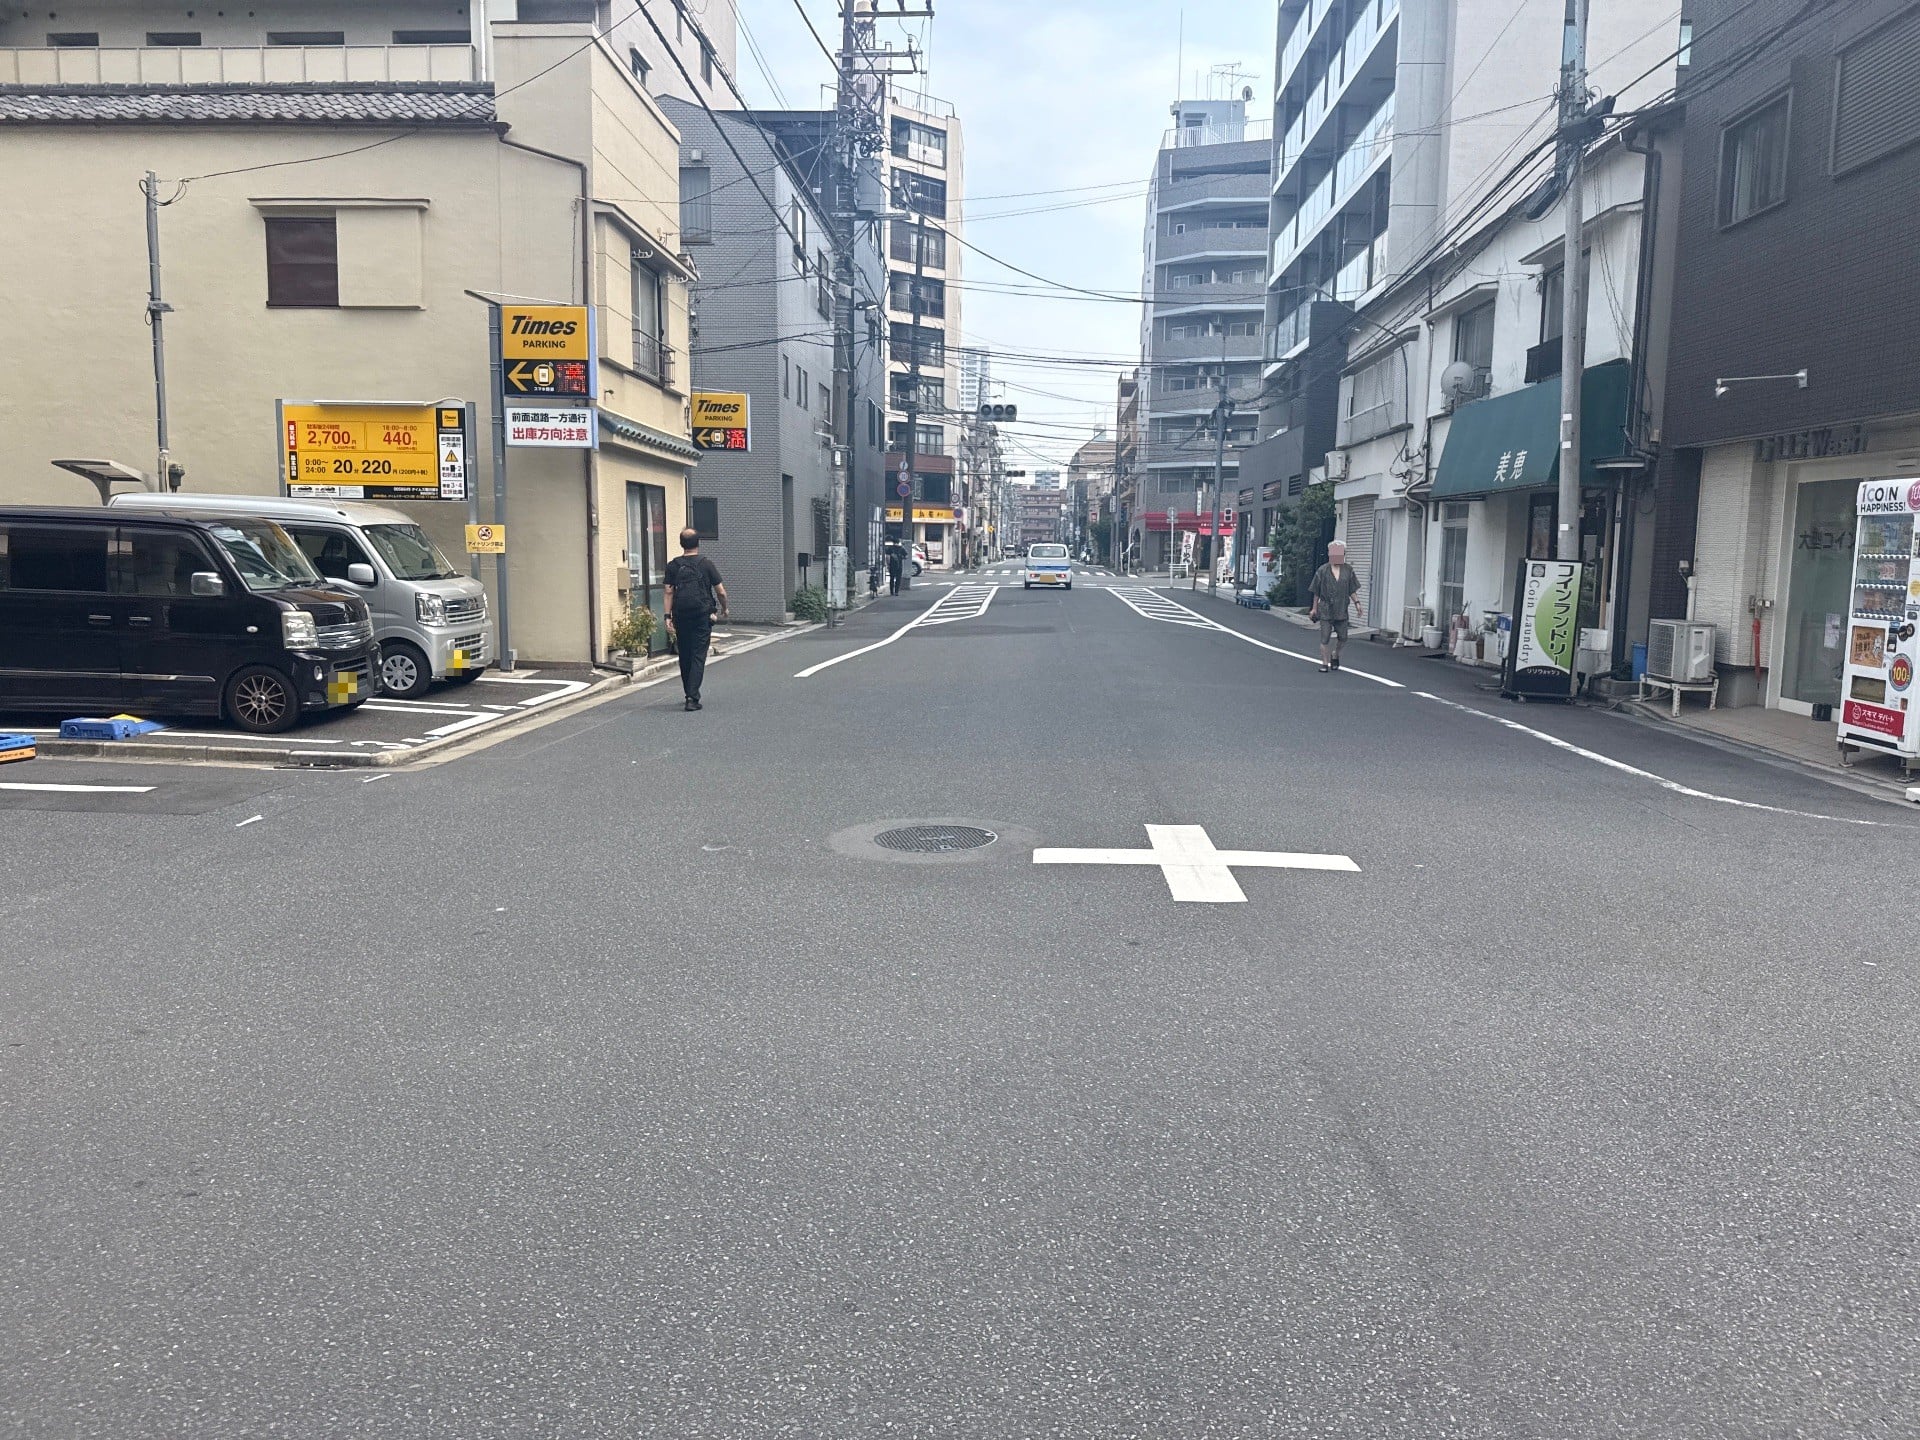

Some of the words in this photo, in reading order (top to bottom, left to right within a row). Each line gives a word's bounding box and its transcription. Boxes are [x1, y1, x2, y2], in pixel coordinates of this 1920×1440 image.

[511, 315, 577, 336] Times
[523, 340, 566, 349] PARKING
[698, 399, 741, 413] Times
[511, 412, 588, 424] 前面道路一方通行
[512, 427, 588, 441] 出庫方向注意
[1493, 450, 1528, 482] 美恵
[1860, 502, 1906, 512] HAPPINESS!
[1528, 580, 1540, 608] Coin
[1550, 565, 1574, 665] コインランドリー
[1519, 613, 1536, 664] Laundry
